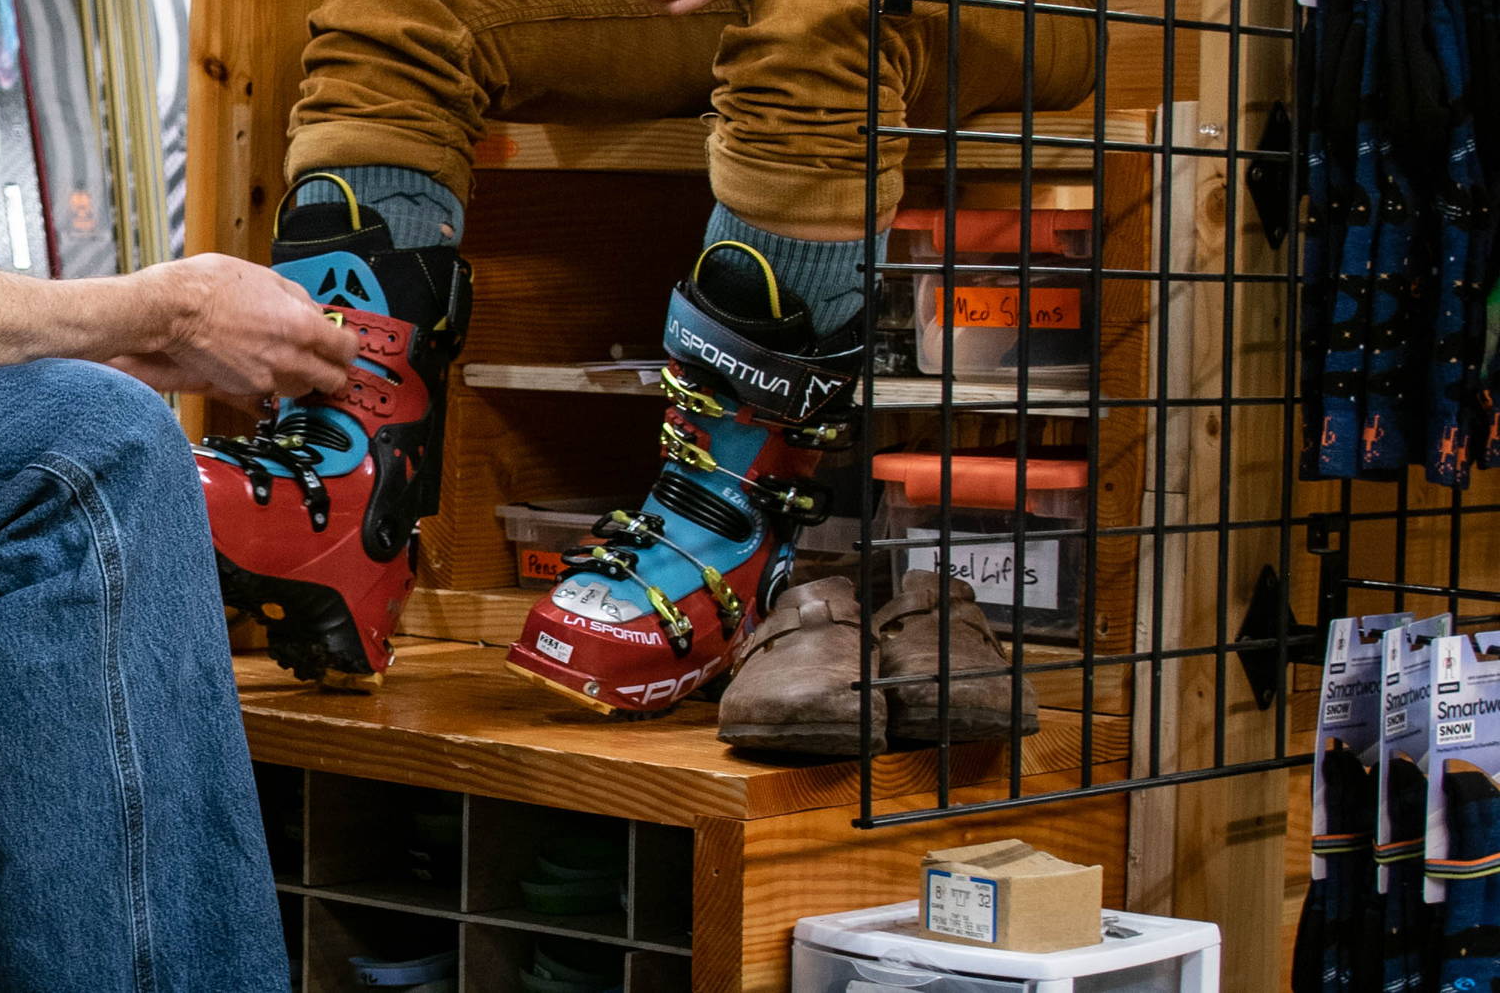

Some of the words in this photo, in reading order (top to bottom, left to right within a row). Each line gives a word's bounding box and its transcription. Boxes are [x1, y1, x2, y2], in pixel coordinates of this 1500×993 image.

[680, 328, 790, 396] SPORTIVA
[528, 554, 557, 575] Pens
[981, 556, 1038, 584] Lifs
[563, 614, 586, 628] LA
[590, 620, 663, 646] SPORTIVA
[1326, 703, 1350, 716] SNOW
[1387, 712, 1406, 728] SNOW
[1439, 722, 1472, 736] SNOW
[978, 893, 991, 908] 32
